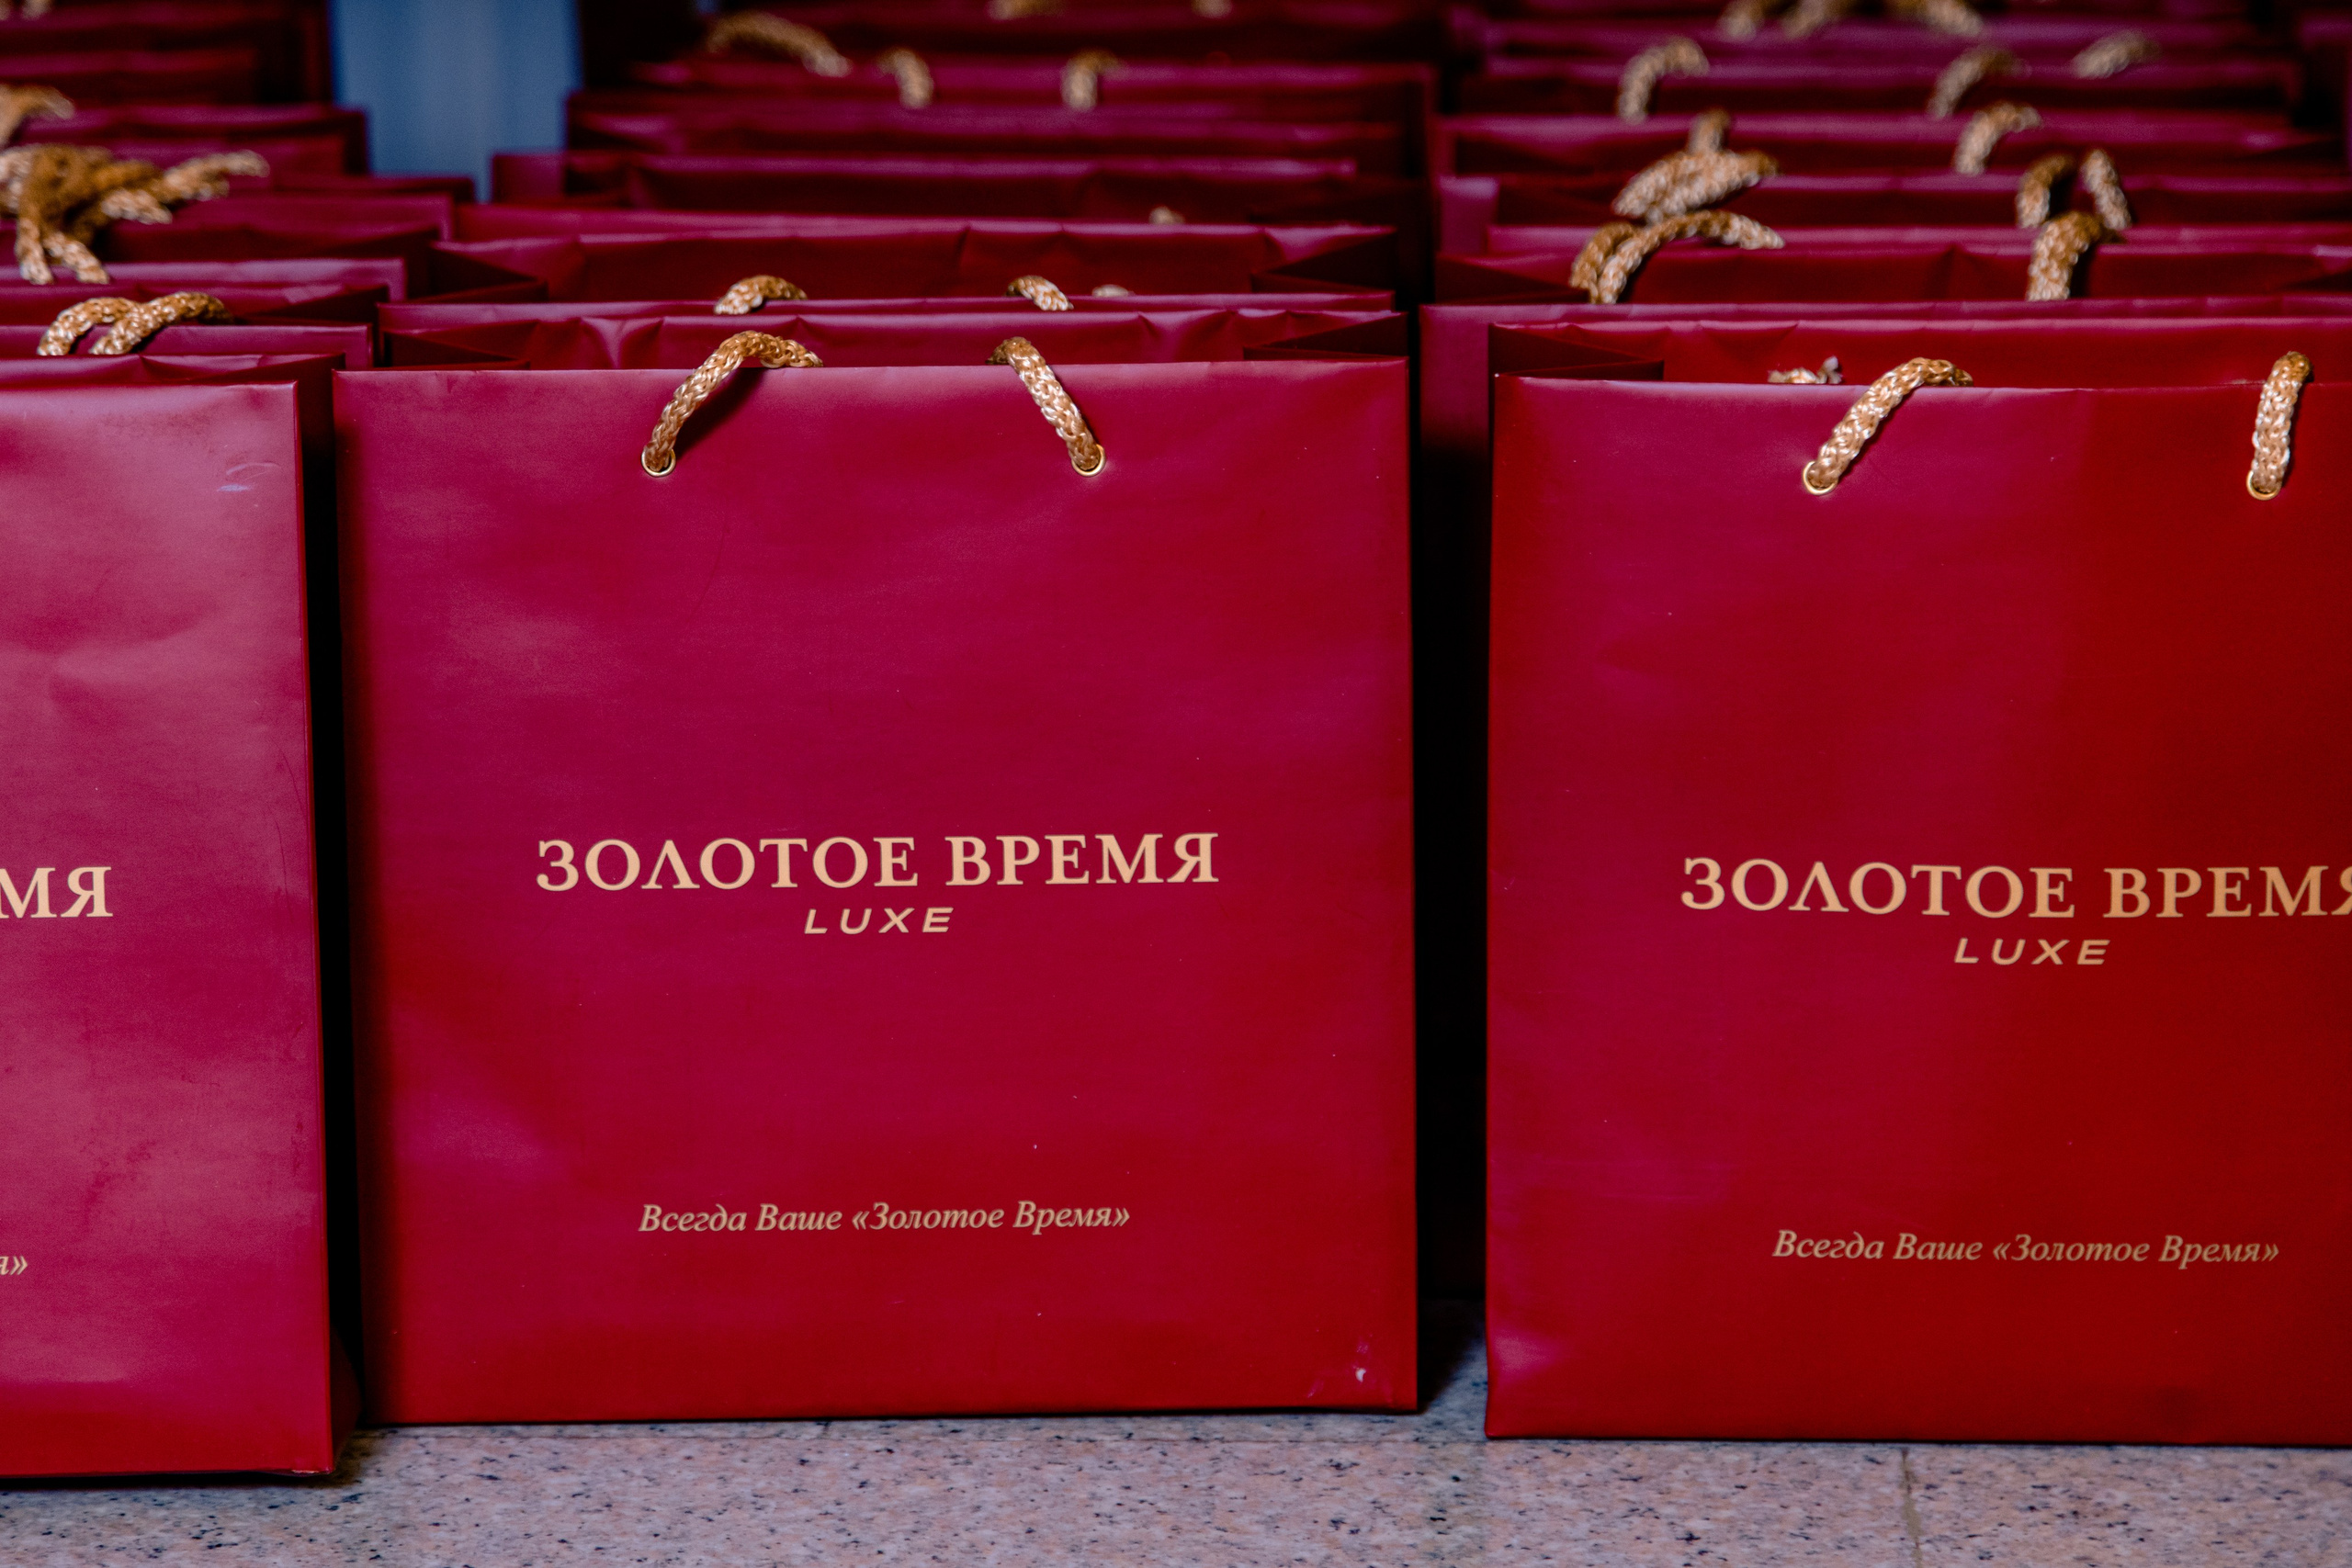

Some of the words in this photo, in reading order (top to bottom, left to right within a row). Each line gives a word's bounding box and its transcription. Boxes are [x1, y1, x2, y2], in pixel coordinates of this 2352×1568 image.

[536, 836, 919, 892] ЗОЛОТОЕ
[944, 831, 1220, 886] ВРЕМЯ
[1680, 856, 2075, 919] ЗОЛОТОЕ
[803, 906, 955, 935] LUXE
[1953, 937, 2110, 965] LUXE
[638, 1203, 748, 1233] Всегда
[754, 1202, 843, 1232] Ваше
[852, 1201, 1005, 1230] «Золотое
[1012, 1200, 1131, 1235] Время»
[1771, 1229, 1885, 1259] Всегда
[1893, 1232, 1984, 1261] Ваше
[1992, 1234, 2151, 1262] «Золотое
[2158, 1235, 2279, 1270] Время»
